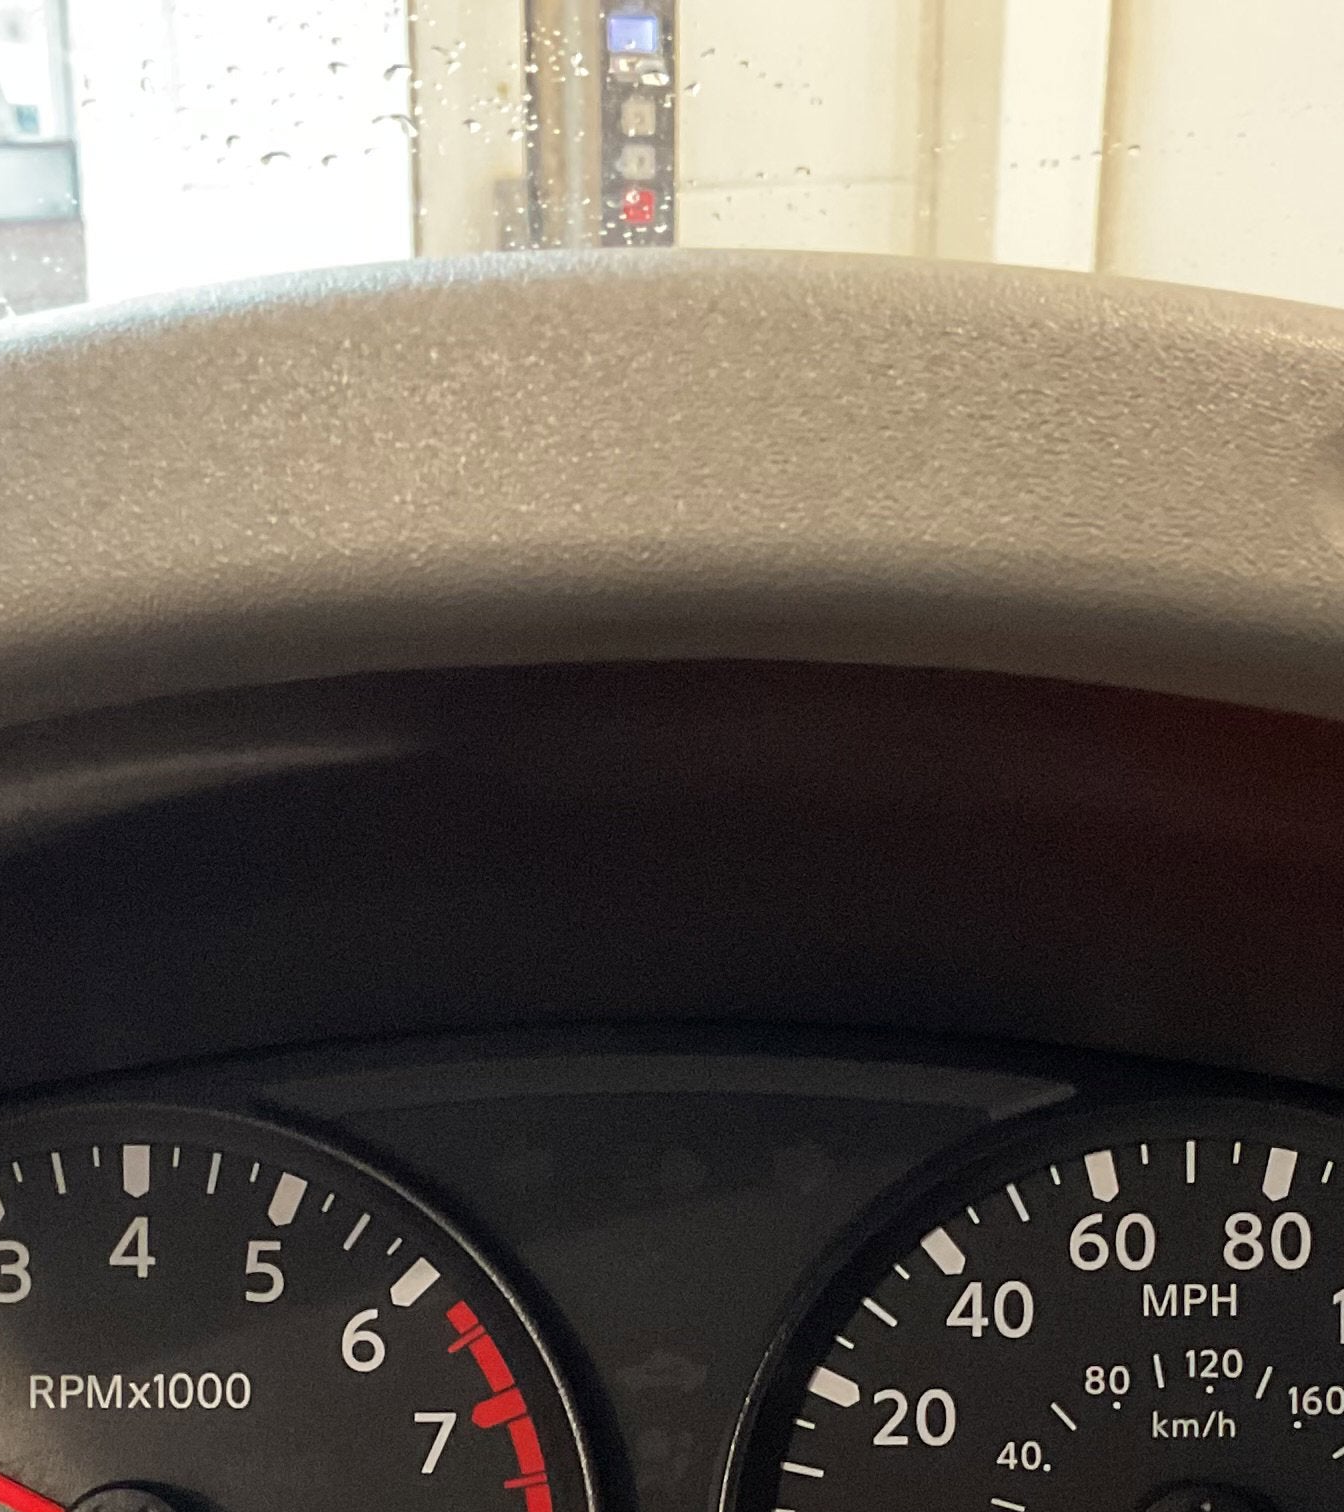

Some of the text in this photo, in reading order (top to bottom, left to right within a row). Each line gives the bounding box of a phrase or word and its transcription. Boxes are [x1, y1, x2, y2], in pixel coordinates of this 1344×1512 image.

[109, 1217, 157, 1280] 4
[1069, 1213, 1156, 1272] 60
[1222, 1213, 1312, 1271] 80
[245, 1240, 285, 1304] 5
[946, 1281, 1034, 1339] 40
[1142, 1285, 1238, 1318] MPH
[341, 1308, 385, 1372] 6
[1185, 1349, 1244, 1379] 120
[1084, 1365, 1130, 1396] 80
[414, 1412, 457, 1474] 7
[871, 1389, 957, 1447] 20
[1151, 1411, 1237, 1441] km/h
[996, 1441, 1043, 1471] 40
